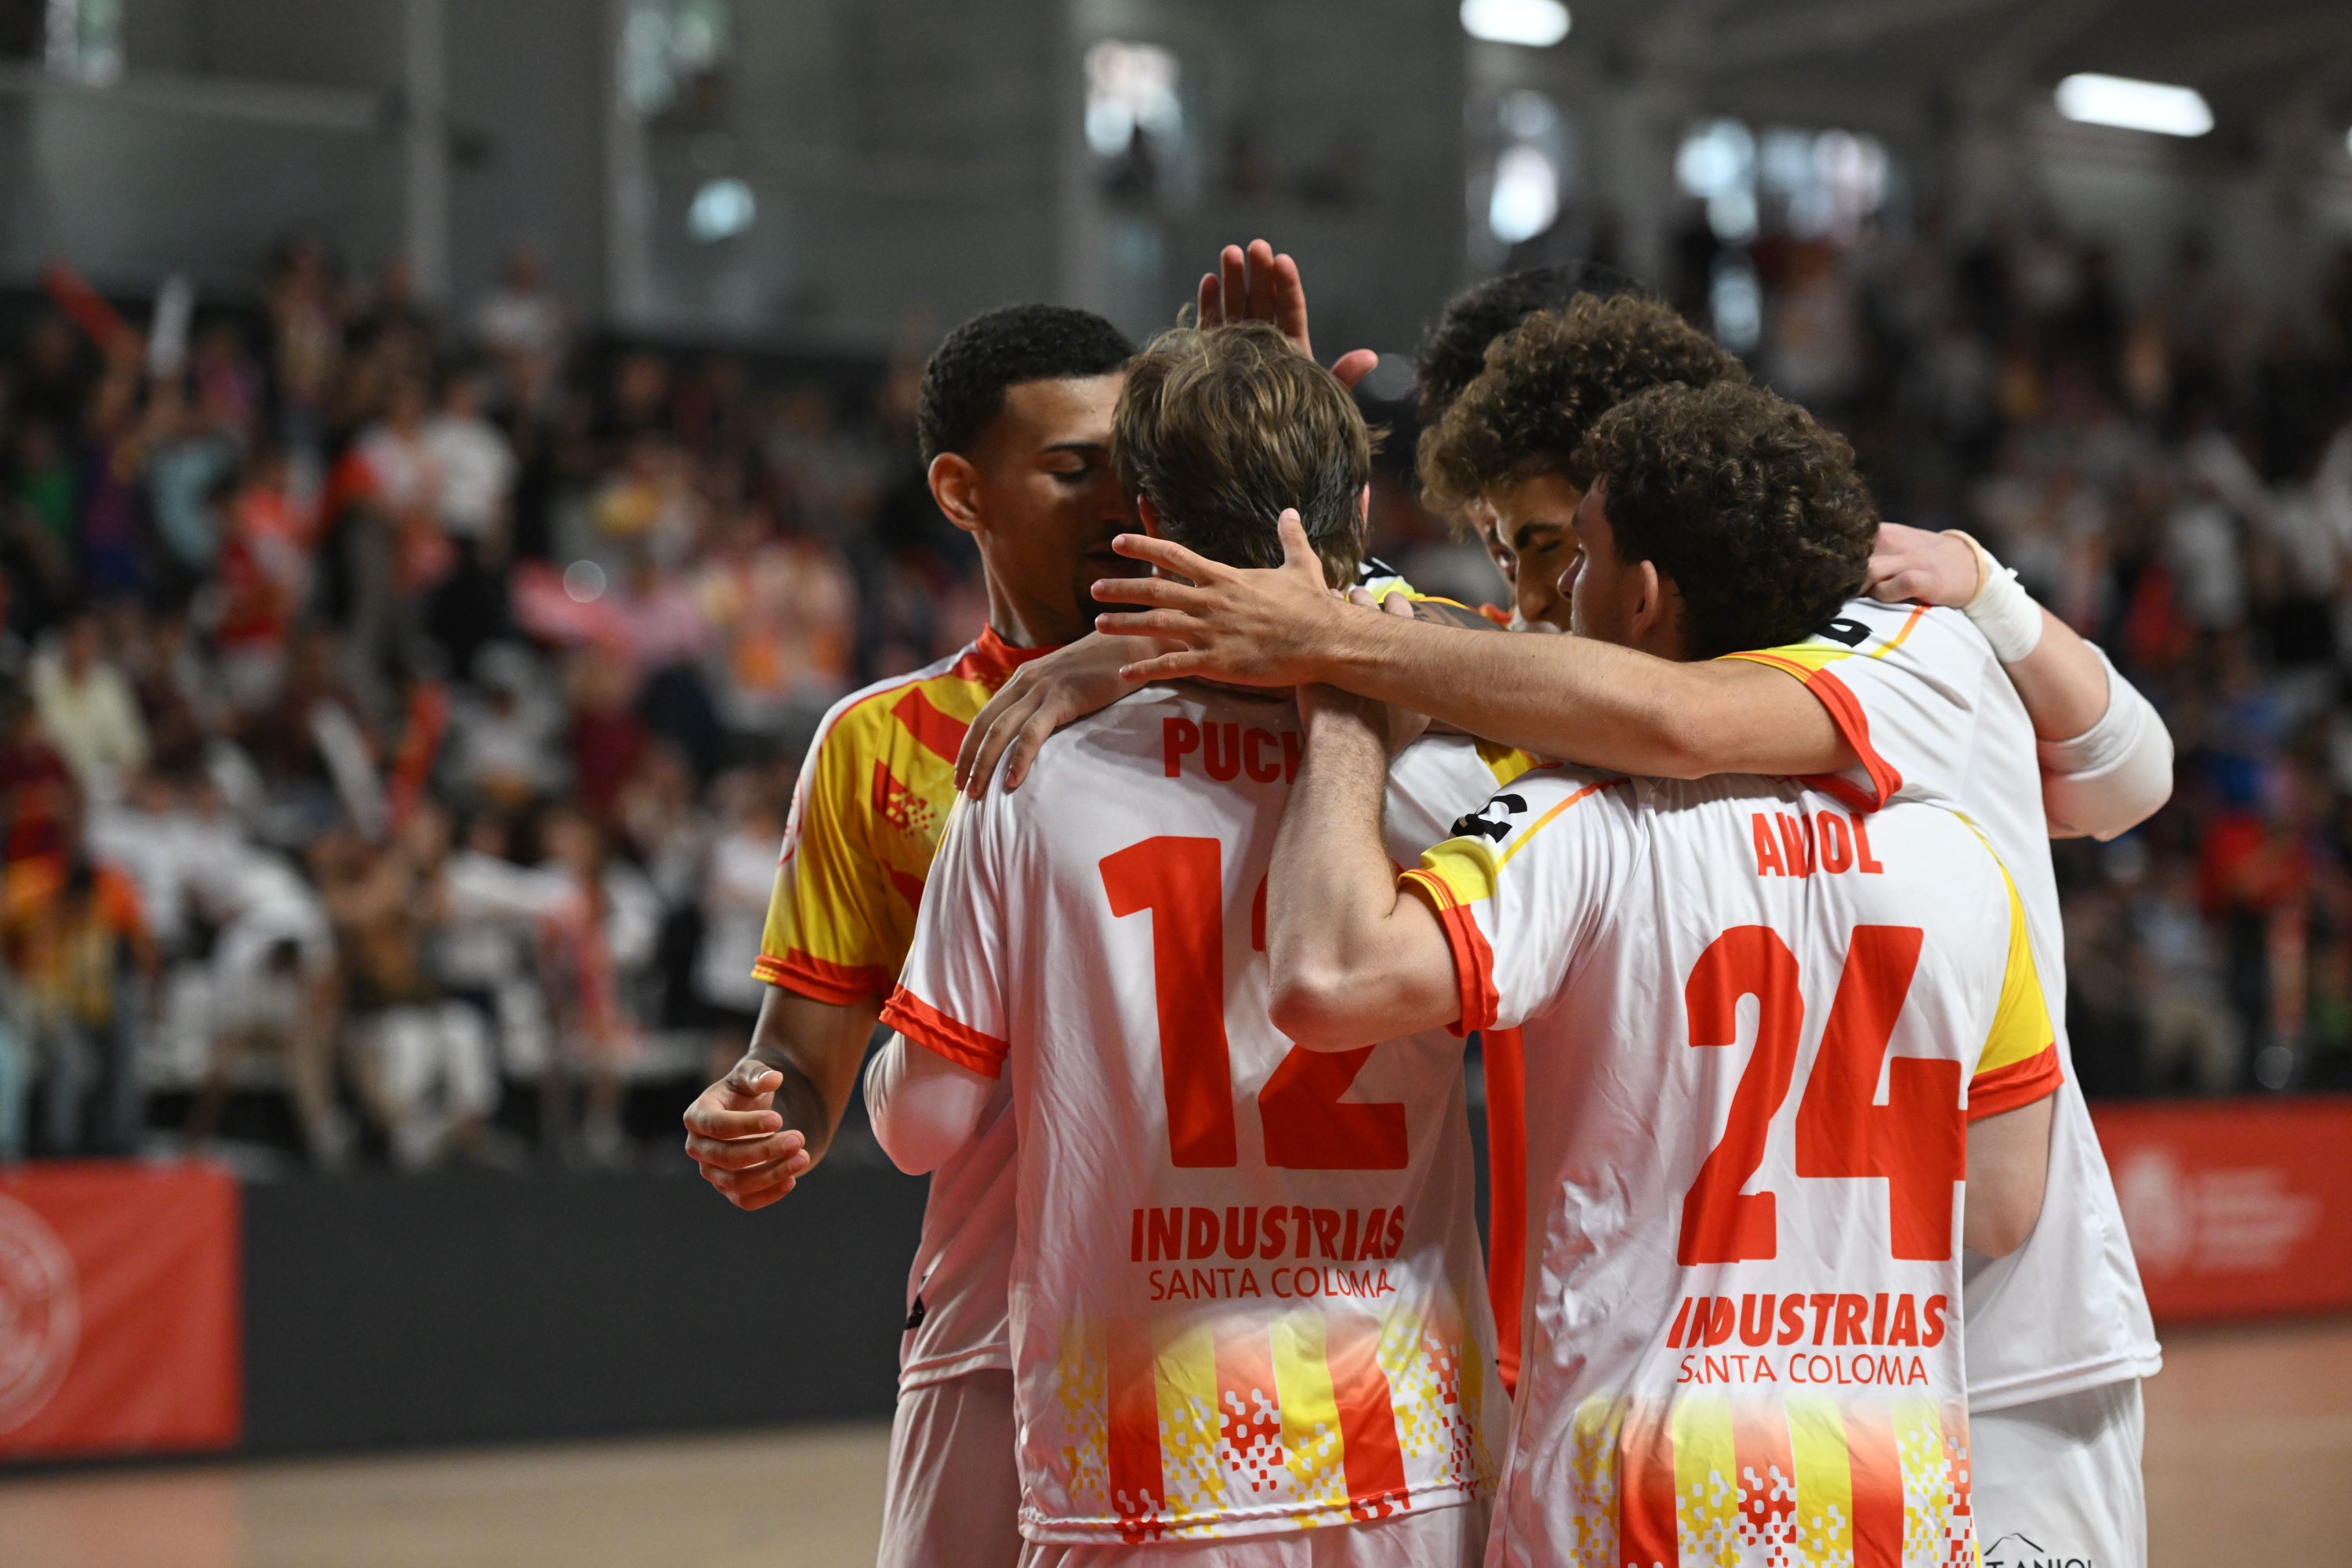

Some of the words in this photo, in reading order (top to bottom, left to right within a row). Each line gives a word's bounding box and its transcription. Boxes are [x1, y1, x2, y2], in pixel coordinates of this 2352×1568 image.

[1676, 924, 1967, 1267] 24
[1130, 1204, 1405, 1263] INDUSTRIAS
[1149, 1267, 1261, 1301] SANTA
[1271, 1265, 1396, 1298] COLOMA
[1666, 1293, 1948, 1348] INDUSTRIAS
[1789, 1352, 1929, 1385] COLOMA
